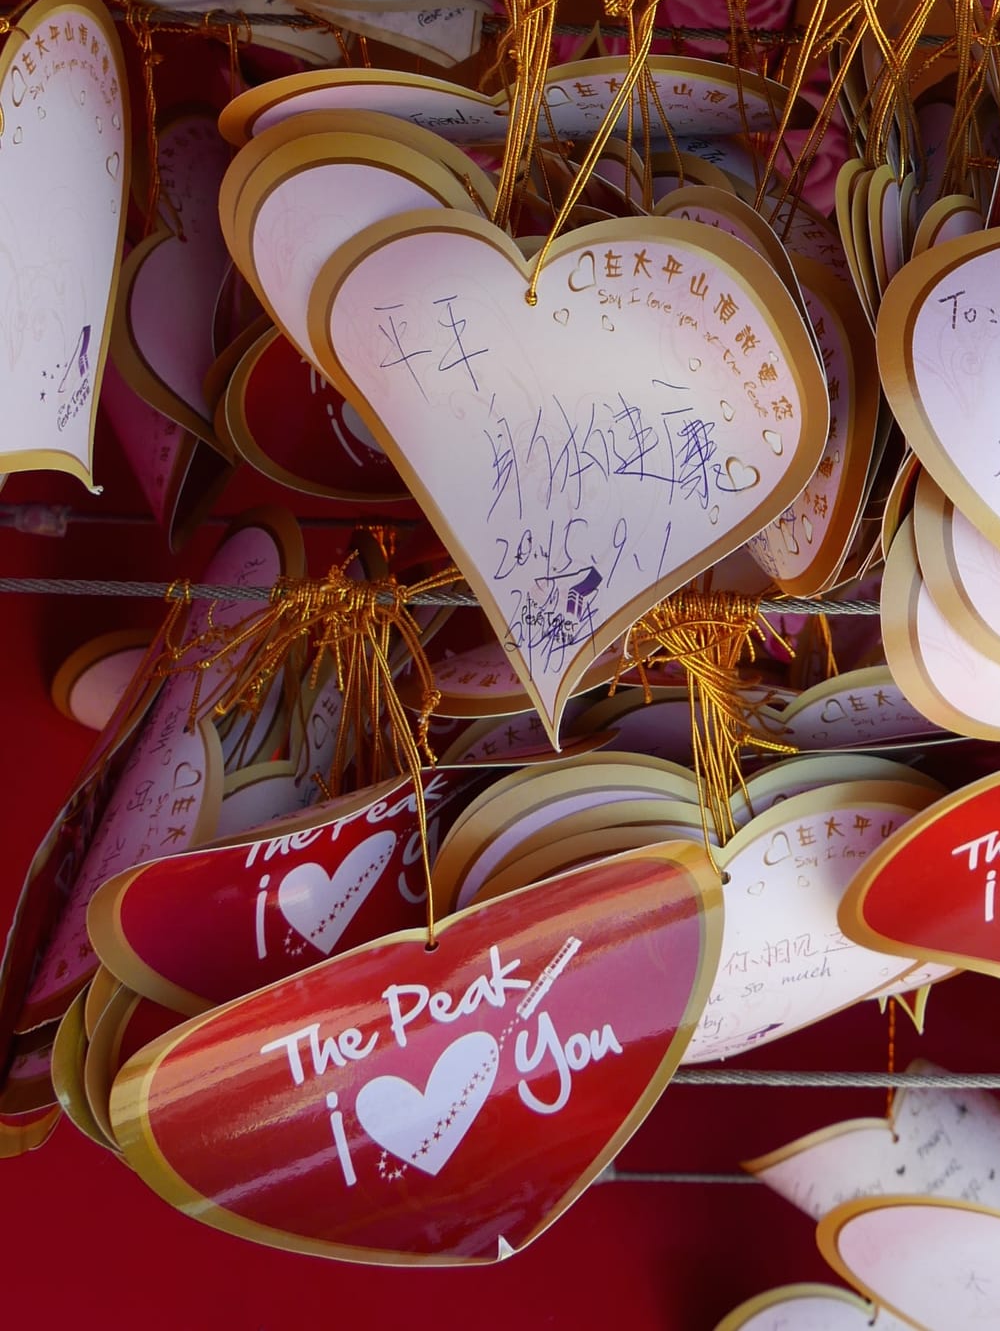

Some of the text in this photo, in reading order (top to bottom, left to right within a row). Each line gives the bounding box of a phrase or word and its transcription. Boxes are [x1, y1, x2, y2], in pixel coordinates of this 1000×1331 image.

[646, 291, 673, 314] love
[256, 874, 270, 960] i
[984, 869, 996, 922] i
[260, 945, 532, 1085] The Peak
[326, 1011, 623, 1187] i You
